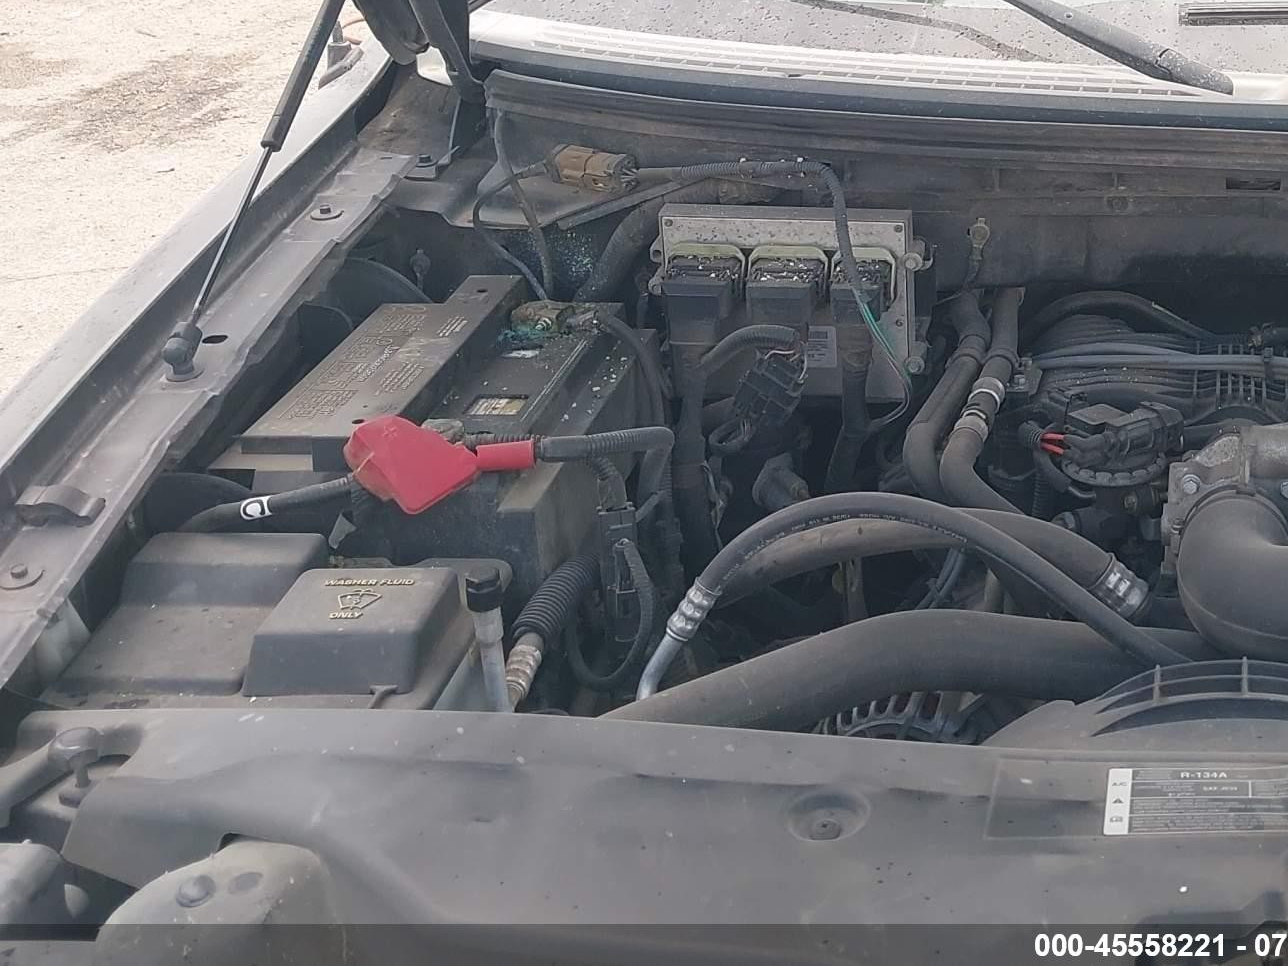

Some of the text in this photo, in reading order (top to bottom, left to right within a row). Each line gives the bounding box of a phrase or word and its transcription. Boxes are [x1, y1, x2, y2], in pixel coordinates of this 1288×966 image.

[325, 578, 415, 586] WASHER FLUID
[329, 611, 363, 619] ONLY
[1180, 771, 1228, 779] R-134A
